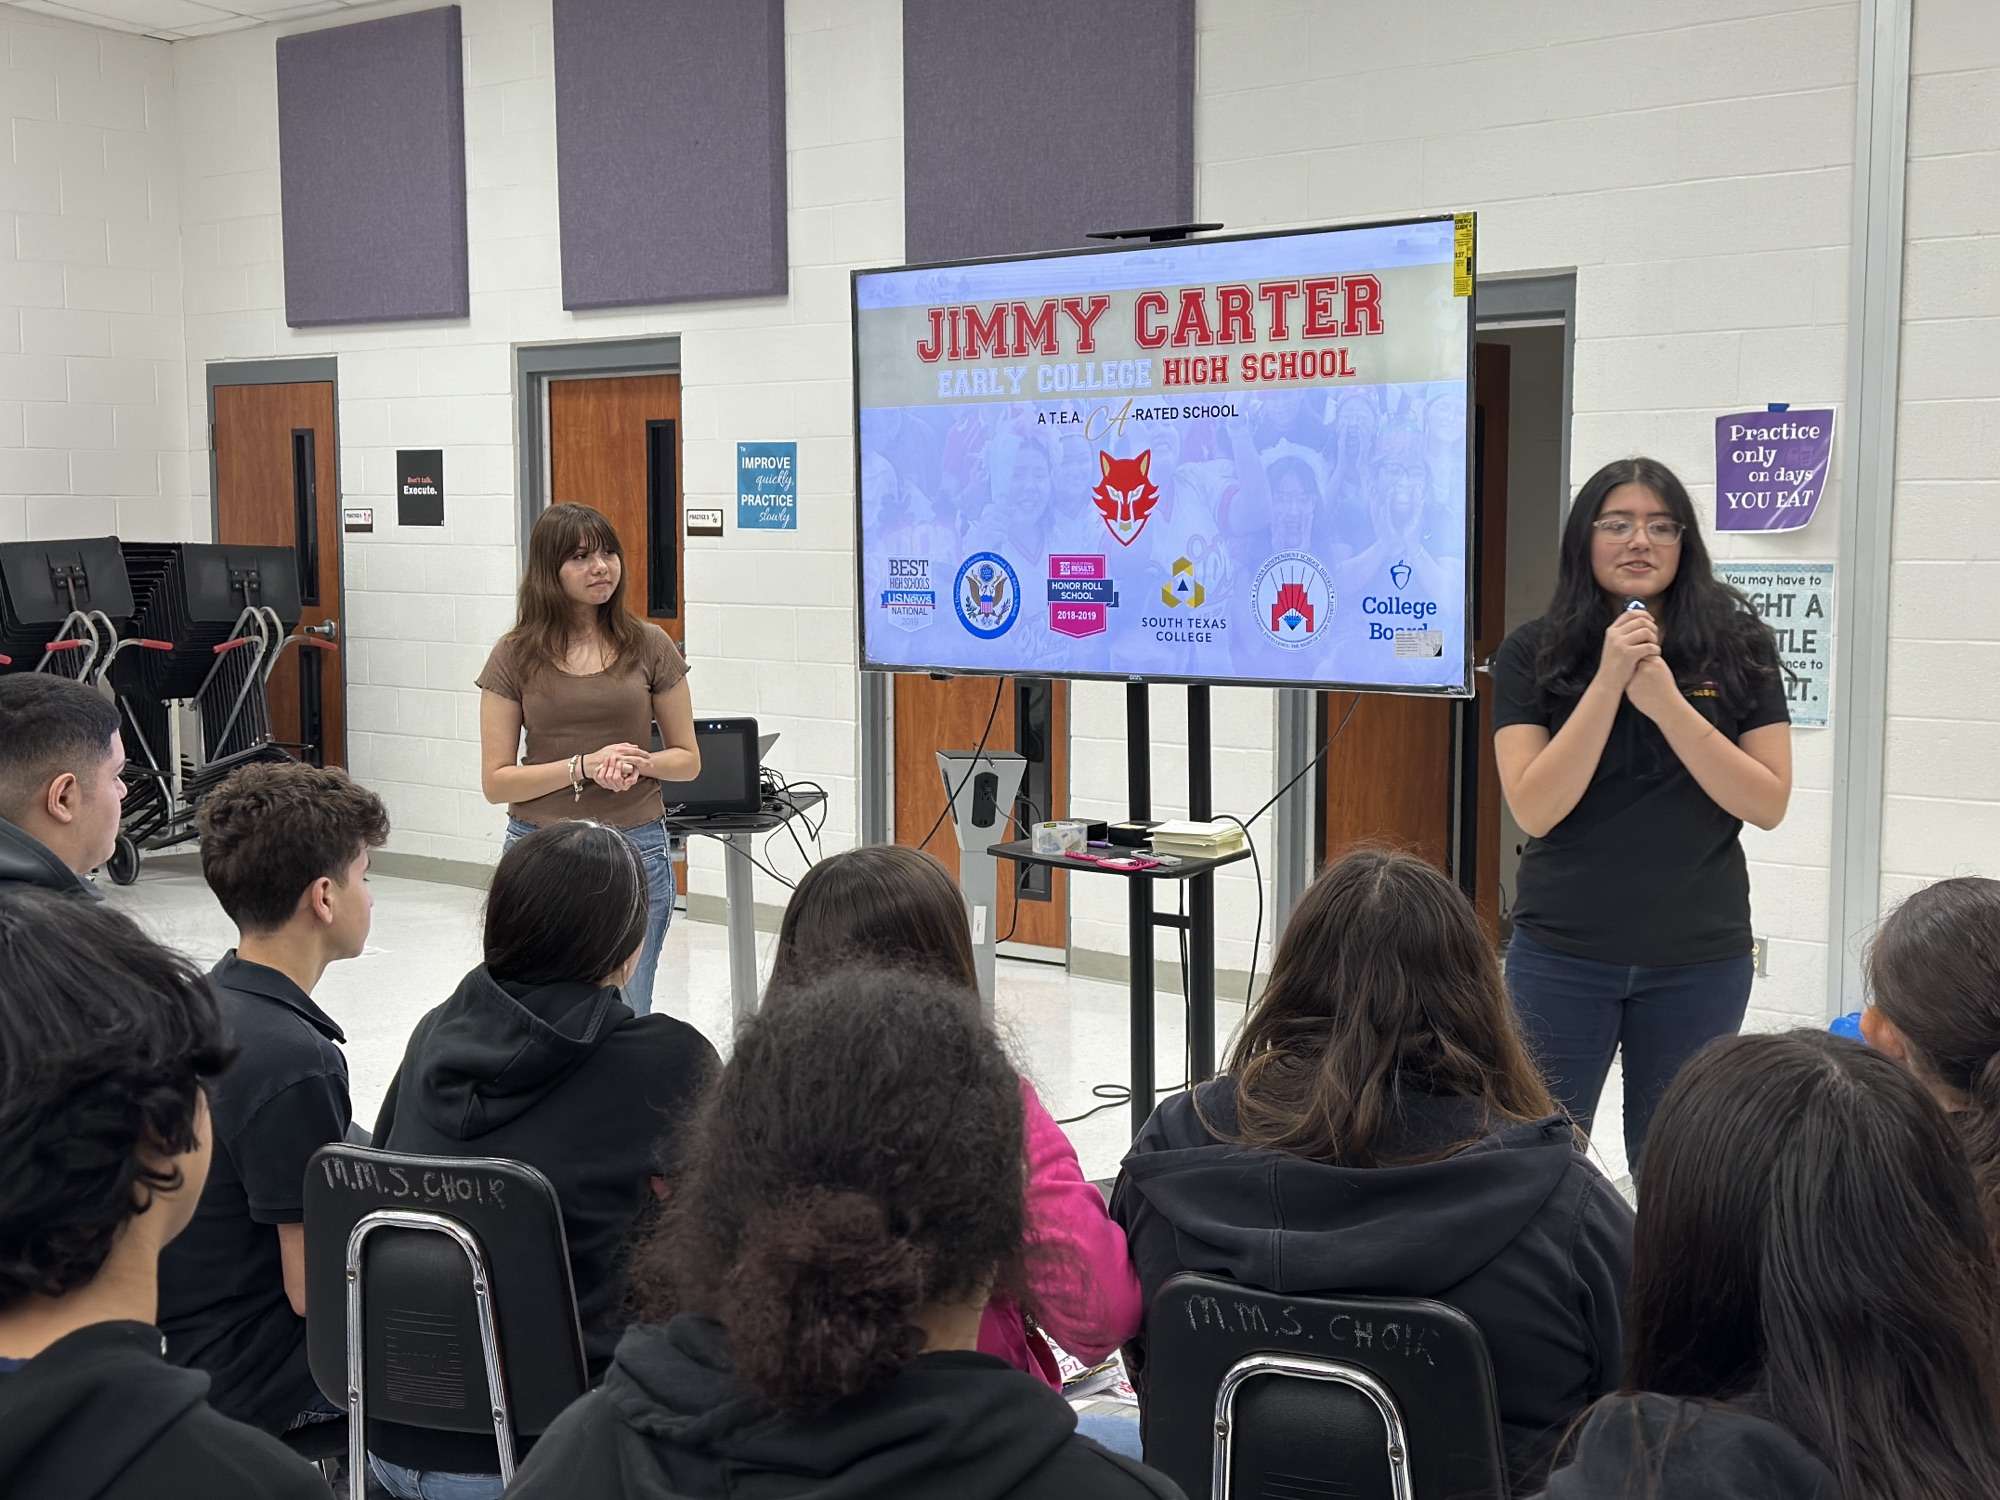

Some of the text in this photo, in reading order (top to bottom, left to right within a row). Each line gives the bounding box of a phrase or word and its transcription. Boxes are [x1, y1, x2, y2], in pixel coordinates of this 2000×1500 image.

[917, 273, 1385, 362] JIMMY CARTER
[937, 347, 1356, 397] EARLY COLLEGE HIGH SCHOOL
[1037, 413, 1046, 424] A
[1183, 404, 1239, 419] SCHOOL
[1730, 423, 1820, 442] Practice
[741, 457, 791, 469] IMPROVE
[1732, 446, 1777, 467] only
[1748, 467, 1814, 486] on days
[403, 485, 438, 495] Execute.
[741, 495, 793, 506] PRACTICE
[1725, 490, 1814, 509] YOU EAT
[889, 559, 929, 576] BEST
[1052, 582, 1103, 591] HONOR ROLL
[1725, 574, 1822, 586] You may have to
[1061, 592, 1094, 600] SCHOOL
[891, 607, 928, 616] NATIONAL
[1362, 596, 1437, 619] College
[1805, 593, 1824, 618] A
[1057, 610, 1097, 620] 2018-2019
[1141, 617, 1226, 629] SOUTH TEXAS
[1156, 631, 1212, 643] COLLEGE
[1810, 659, 1823, 670] to
[423, 1171, 506, 1209] CHOIR
